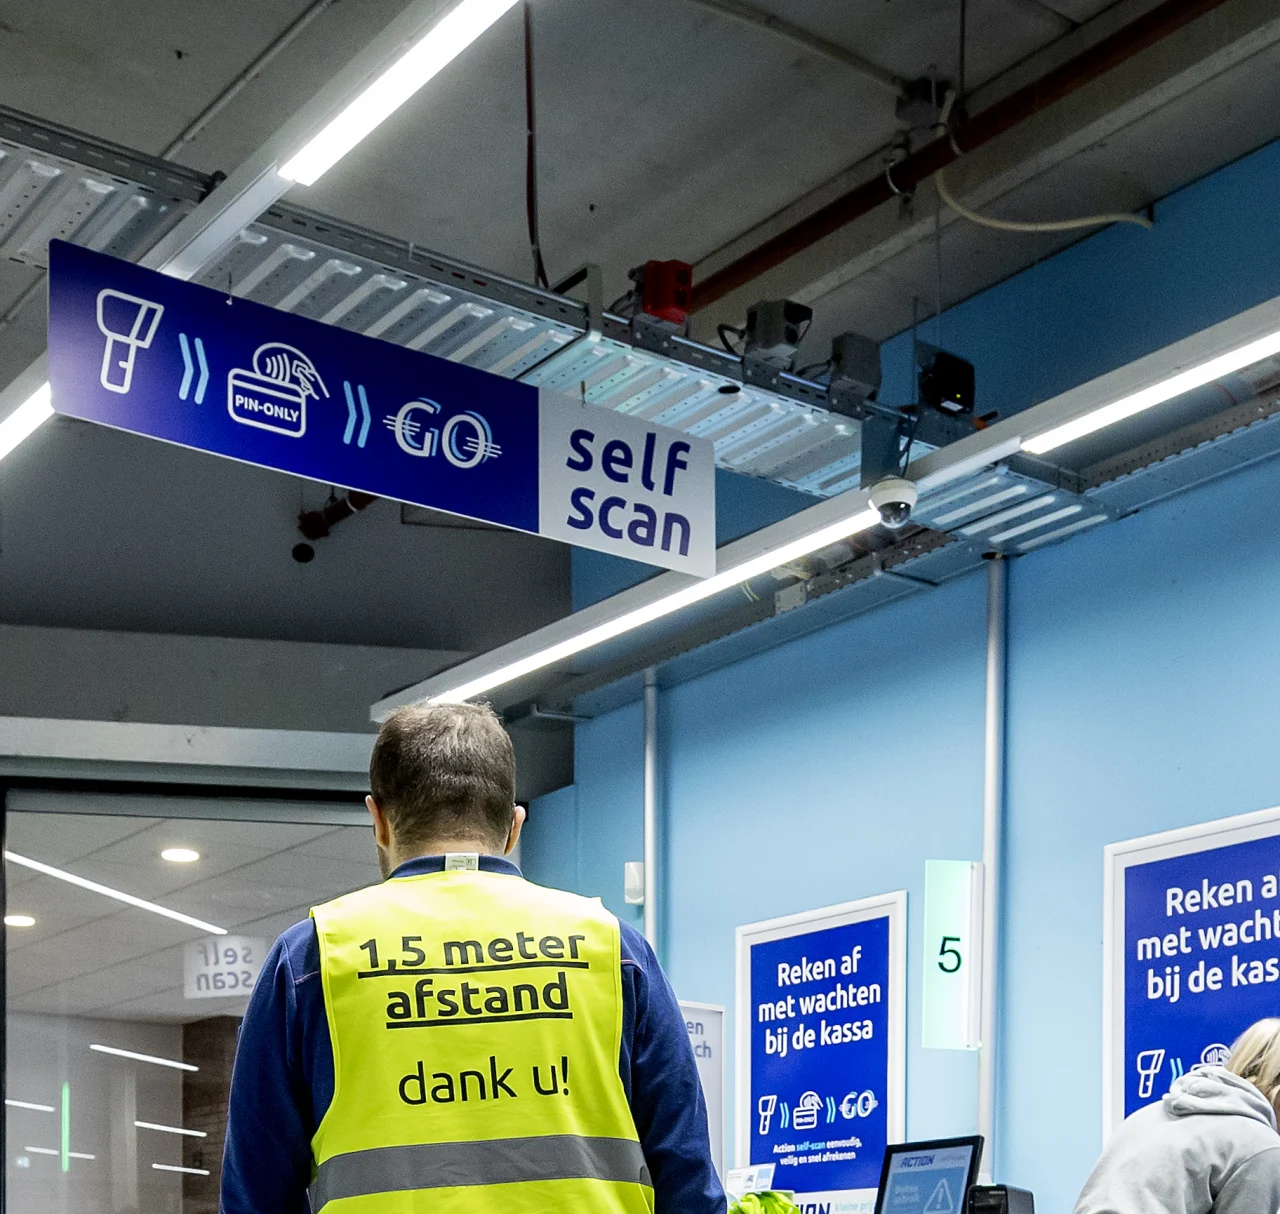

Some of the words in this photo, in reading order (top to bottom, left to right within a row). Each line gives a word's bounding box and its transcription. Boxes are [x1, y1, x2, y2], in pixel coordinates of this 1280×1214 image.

[235, 394, 300, 424] PIN-ONLY
[392, 397, 498, 469] GO
[567, 429, 691, 497] self
[567, 487, 691, 558] scan
[1166, 877, 1253, 917] Reken
[359, 936, 425, 972] 1,5
[445, 931, 585, 966] meter
[938, 936, 962, 973] 5
[1137, 926, 1192, 961] met
[777, 956, 835, 987] Reken
[841, 945, 862, 975] af
[1147, 968, 1180, 1003] bij
[1188, 960, 1222, 992] de
[387, 972, 570, 1019] afstand
[759, 999, 795, 1022] met
[800, 983, 880, 1015] wachten
[765, 1028, 787, 1057] bij
[792, 1027, 815, 1050] de
[821, 1018, 872, 1045] kassa
[399, 1055, 517, 1105] dank
[533, 1056, 570, 1096] u!
[839, 1090, 878, 1119] GO
[773, 1143, 795, 1154] Action
[797, 1141, 825, 1151] self-scan
[822, 1151, 856, 1162] afrekenen
[901, 1155, 934, 1168] ACTION
[835, 1202, 858, 1211] kleine
